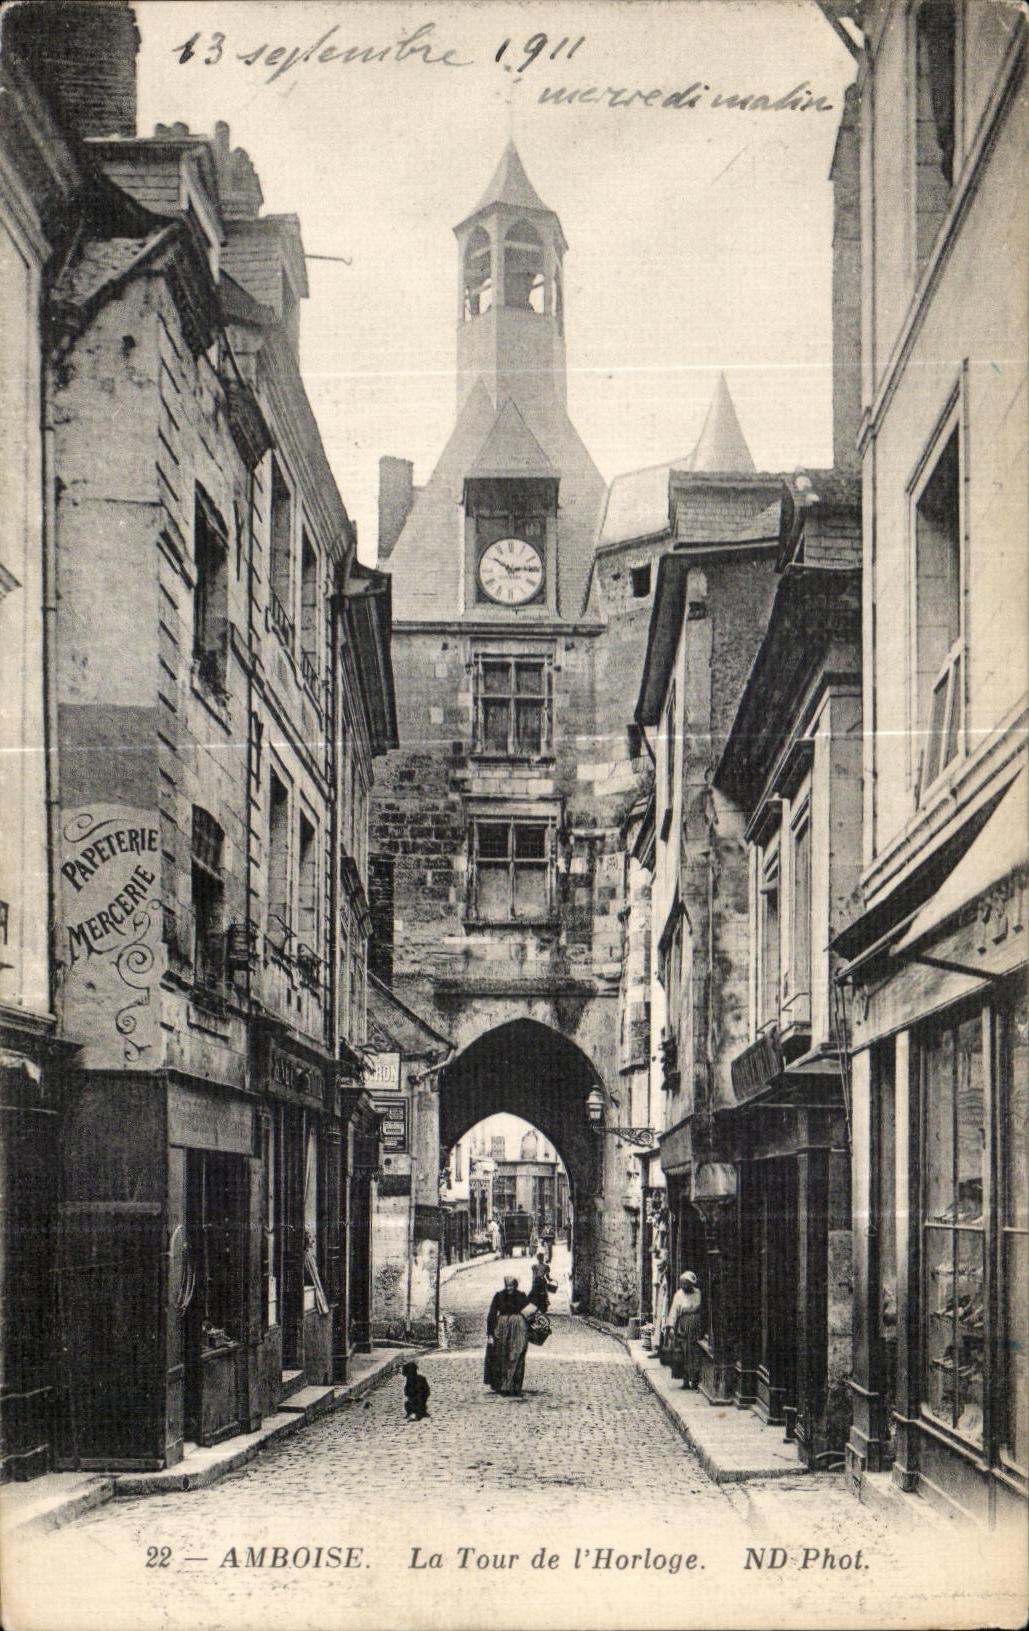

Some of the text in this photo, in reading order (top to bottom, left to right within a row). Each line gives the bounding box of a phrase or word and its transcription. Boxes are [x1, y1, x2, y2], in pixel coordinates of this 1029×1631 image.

[172, 22, 586, 85] 13 septembre 1911
[61, 828, 158, 892] PAPETERIE
[66, 864, 156, 968] MERCERIE
